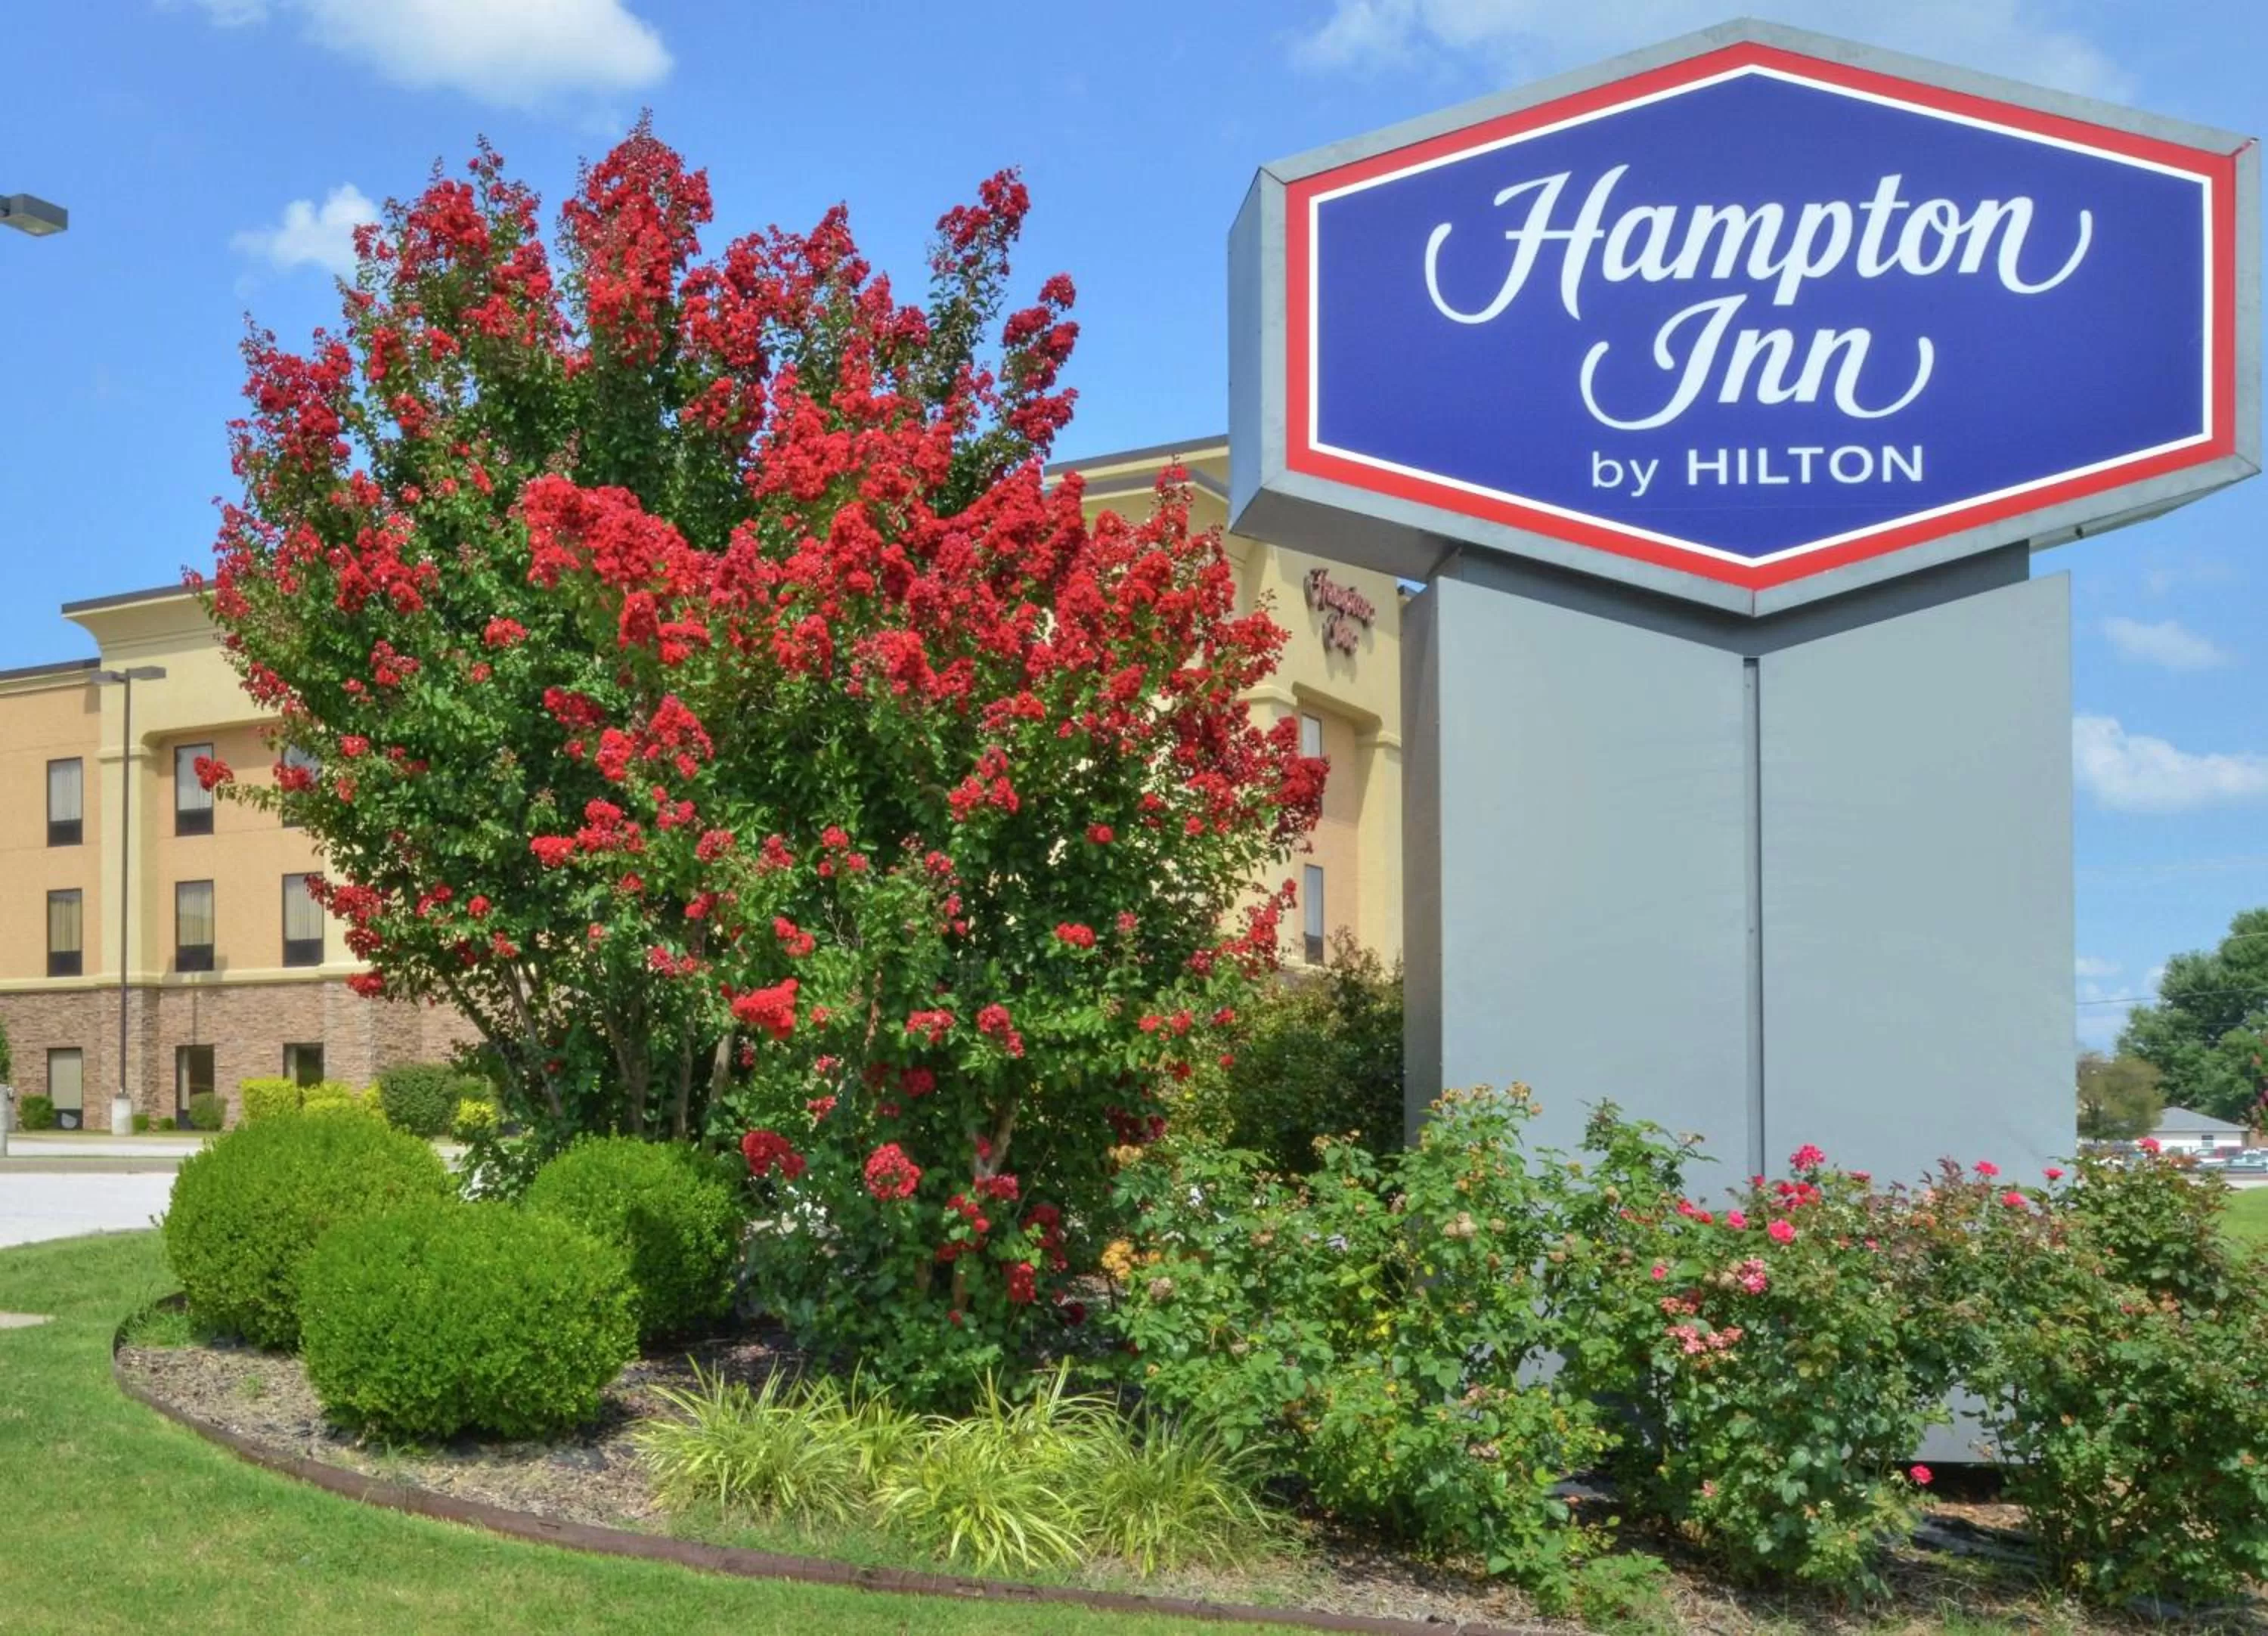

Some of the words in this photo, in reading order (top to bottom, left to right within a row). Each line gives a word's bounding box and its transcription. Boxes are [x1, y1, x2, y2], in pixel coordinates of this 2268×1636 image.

[1424, 165, 2093, 324] Hampton
[1580, 293, 1935, 430] Inn
[1591, 451, 1659, 496] by
[1687, 445, 1923, 485] HILTON
